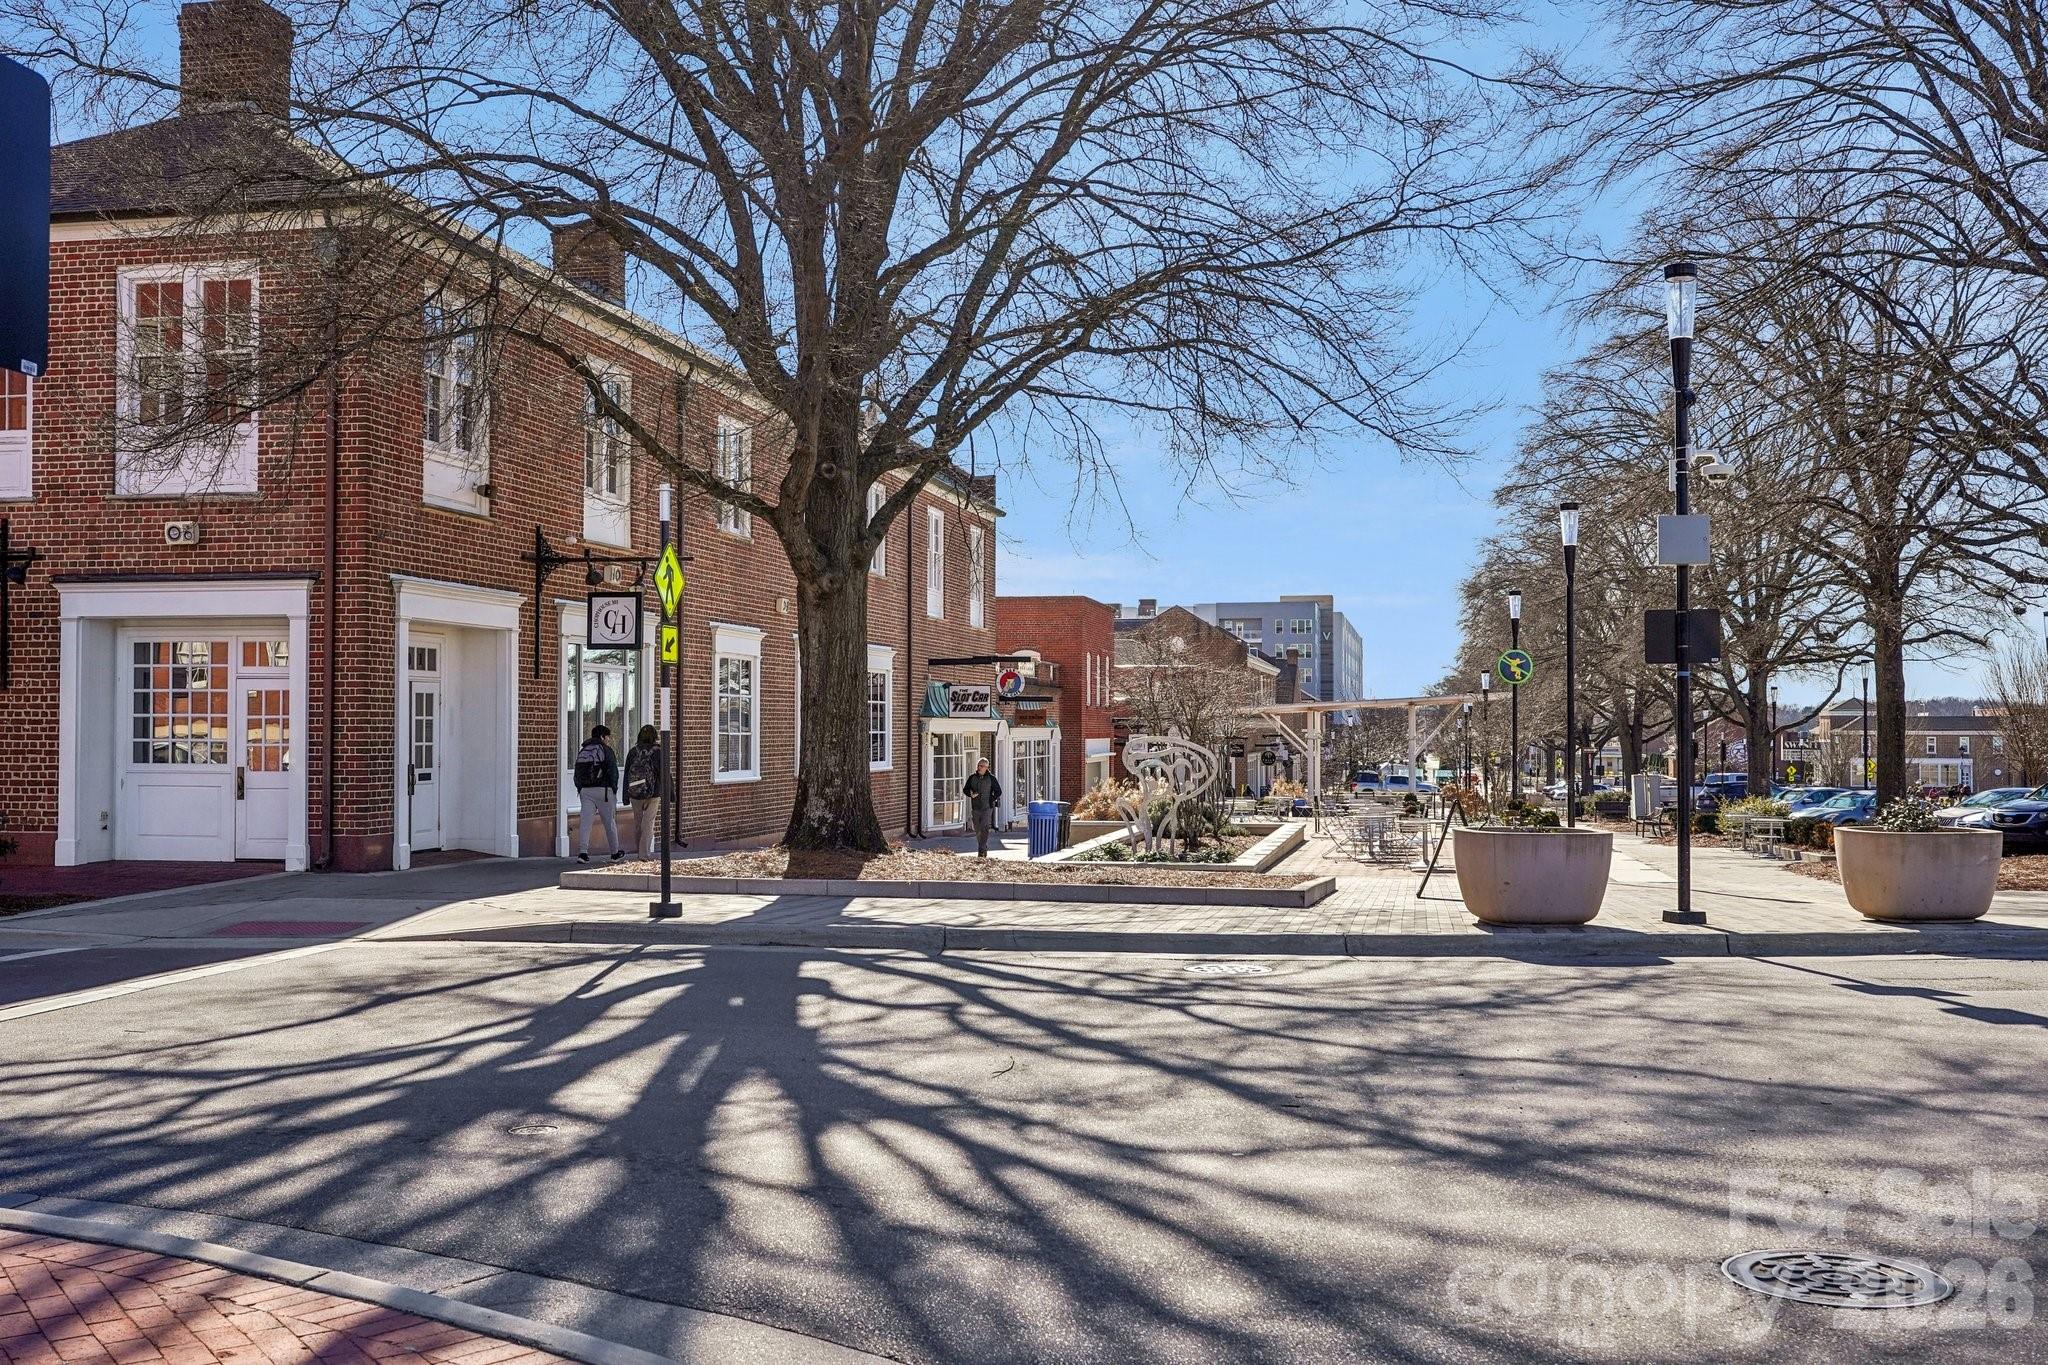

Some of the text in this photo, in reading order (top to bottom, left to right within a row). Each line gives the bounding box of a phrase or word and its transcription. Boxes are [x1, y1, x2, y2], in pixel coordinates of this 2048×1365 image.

[951, 691, 972, 701] SLOT
[972, 691, 989, 702] CAR
[952, 703, 988, 712] TRACK
